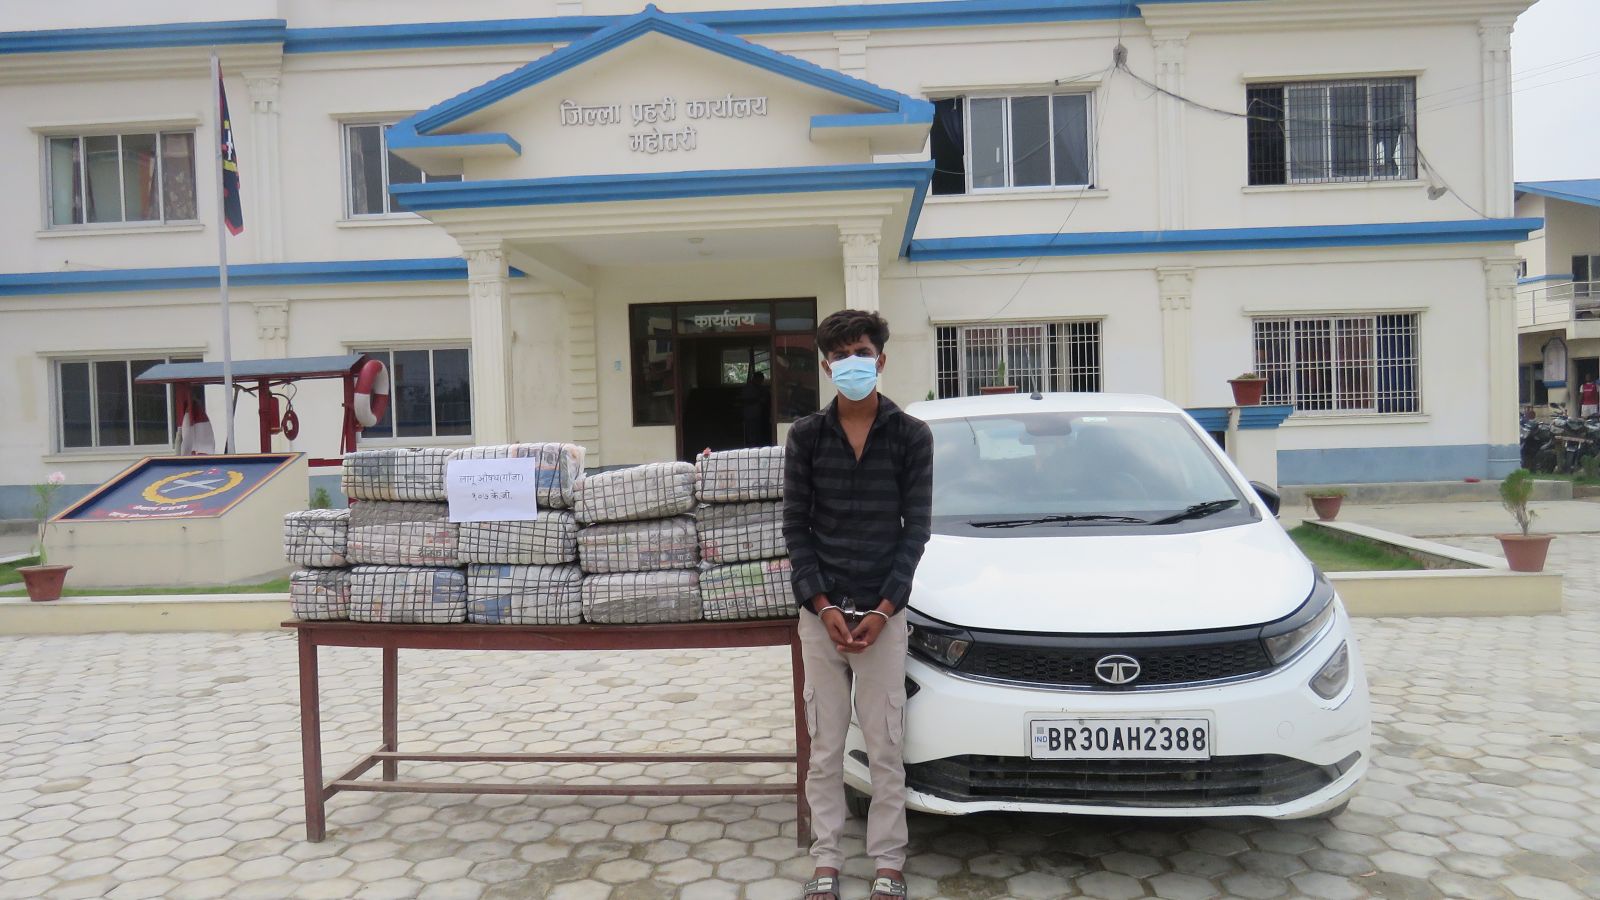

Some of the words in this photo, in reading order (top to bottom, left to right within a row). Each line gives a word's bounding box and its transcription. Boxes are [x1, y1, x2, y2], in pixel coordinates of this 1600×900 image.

[560, 99, 621, 126] जिल्ला
[630, 96, 677, 127] प्रहरी
[686, 93, 768, 120] कार्यालय
[694, 309, 756, 328] कार्यालय
[1034, 735, 1048, 743] IND
[1048, 727, 1206, 751] BR30AH2388
